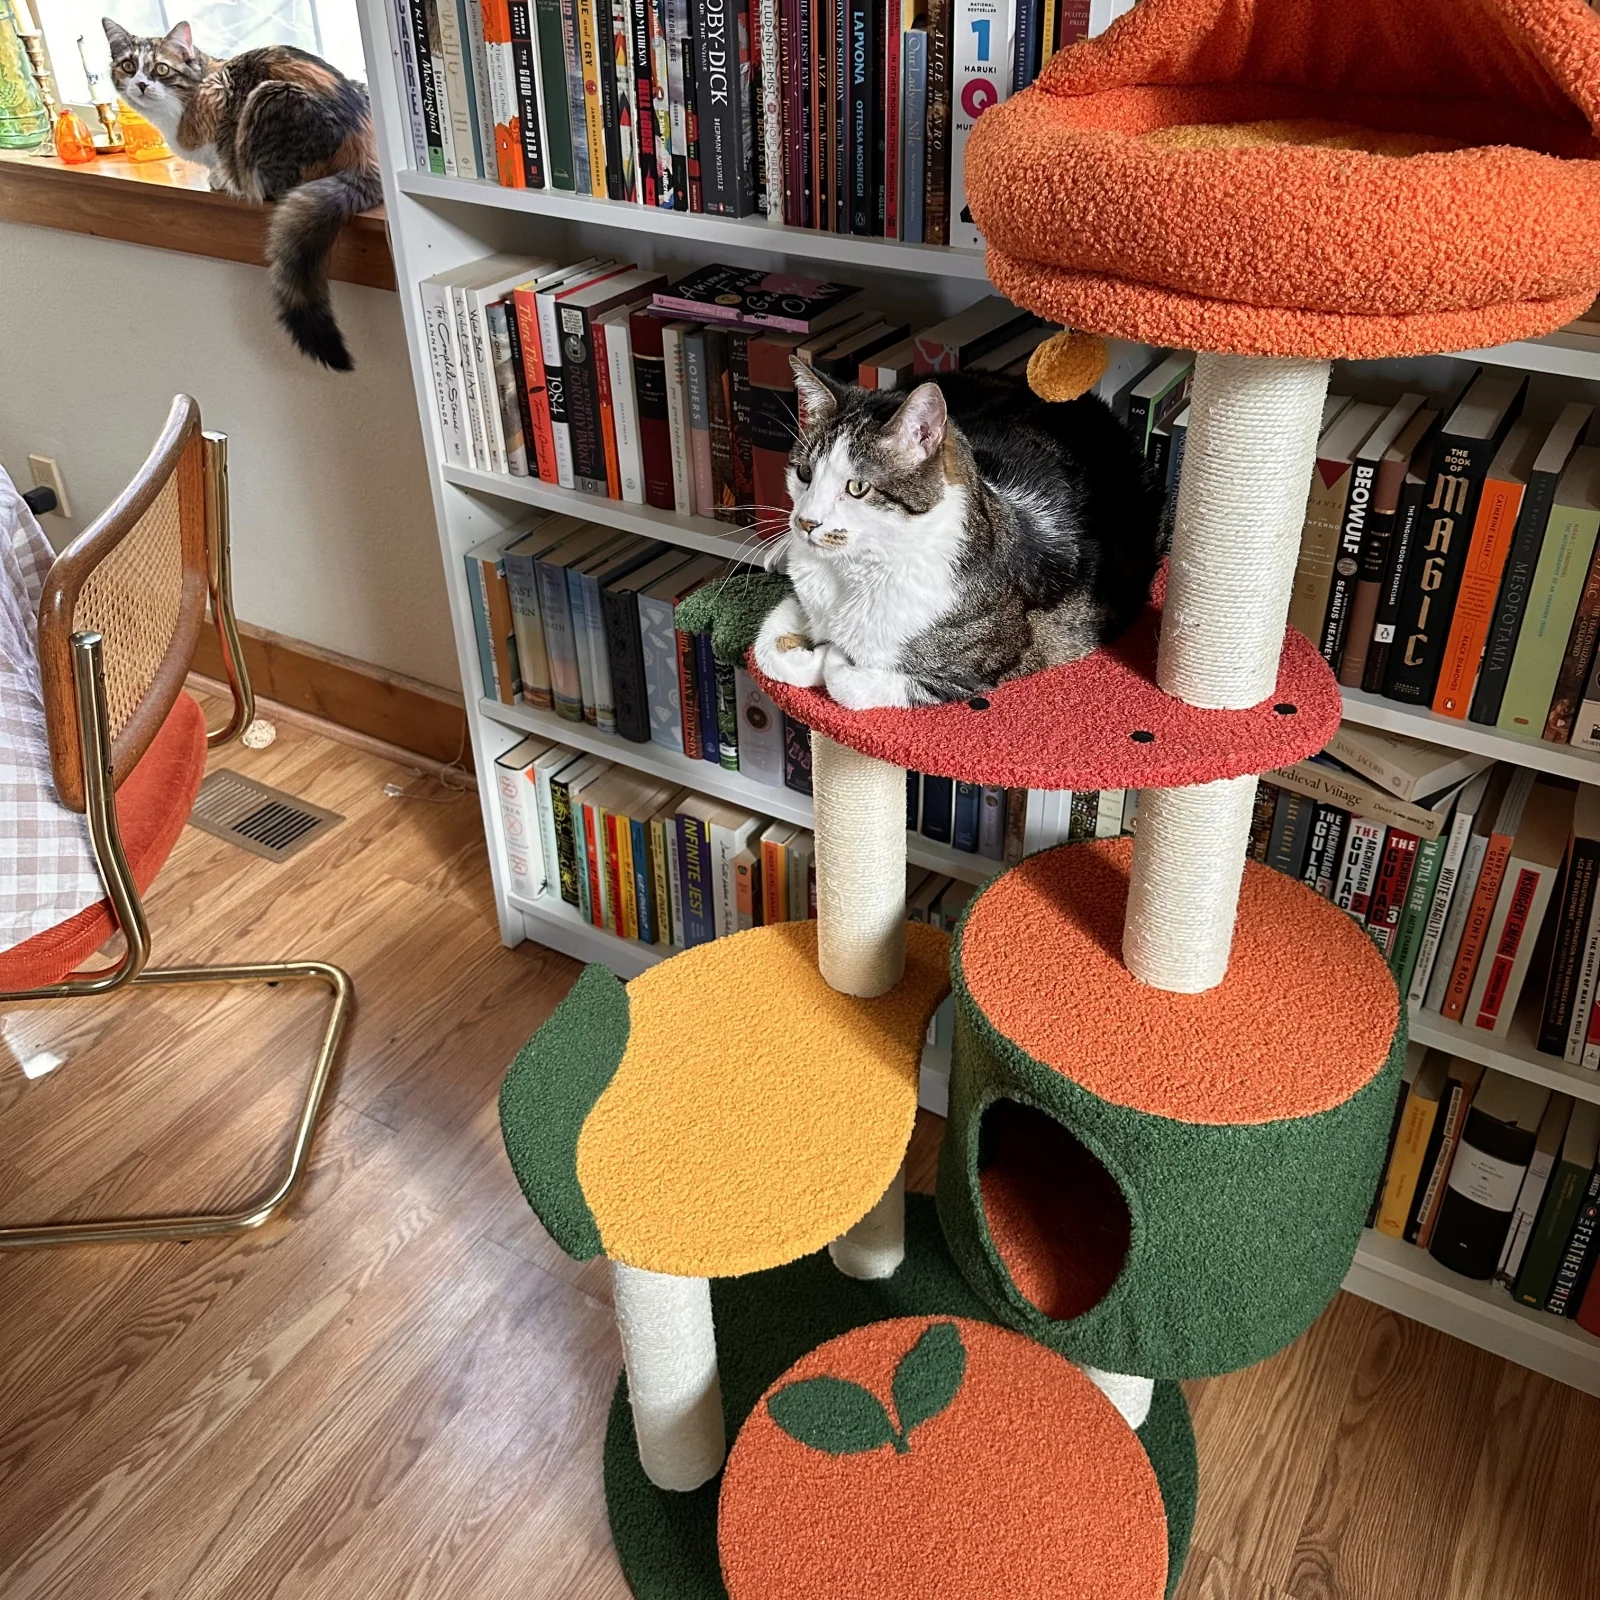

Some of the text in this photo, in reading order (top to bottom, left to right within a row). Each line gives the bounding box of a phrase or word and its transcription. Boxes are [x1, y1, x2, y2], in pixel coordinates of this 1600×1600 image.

[583, 19, 593, 67] and CRY
[637, 20, 648, 67] MATHESON
[667, 9, 676, 42] RAZOR'S
[801, 20, 809, 63] BLUEST
[853, 11, 865, 85] LAPVONA
[970, 18, 991, 62] 1
[415, 8, 440, 135] KILL Mockingbird
[669, 44, 677, 63] EDGE
[706, 0, 728, 107] OBY-DICK
[764, 5, 776, 96] LUD-IN-THE-MIST
[780, 17, 790, 84] BELOVED
[819, 54, 827, 88] JAZZ
[908, 37, 921, 66] Our
[964, 66, 997, 74] HARUKI
[519, 69, 532, 96] GOOD
[908, 68, 922, 97] Lady
[933, 29, 944, 150] ALICE MUNRO
[961, 78, 998, 119] Q
[525, 99, 534, 129] LORD
[605, 95, 613, 128] MANDELO
[640, 110, 654, 155] HOUSE
[908, 119, 921, 147] Nile
[525, 131, 538, 159] BIRD
[714, 118, 724, 192] HERMAN MELVILLE
[769, 122, 779, 193] HOPE MIRRLEES
[855, 100, 864, 197] OTTESSA MOSHFEGH
[678, 267, 739, 299] Animal
[717, 271, 767, 294] Farm
[426, 310, 439, 367] FLANNERY
[470, 309, 484, 363] Wise Blood
[490, 315, 503, 361] Jenny Offill
[518, 303, 539, 382] There There
[543, 314, 553, 360] GEORGE
[433, 300, 460, 434] The Complete Stories
[688, 352, 701, 421] MOTHERS
[547, 375, 566, 415] 1984
[1132, 407, 1146, 415] RAO
[569, 365, 592, 475] DOROTHY PARKER
[1176, 433, 1187, 464] NORSE
[1445, 456, 1472, 467] BOOK
[1449, 464, 1464, 473] OF
[1451, 448, 1469, 458] THE
[1342, 466, 1374, 554] BEOWULF
[1483, 493, 1504, 557] CATHERINE BAILEY
[1388, 519, 1413, 606] PENGUIN BOOK EXORCISMS
[1403, 472, 1470, 667] MAGIC
[1331, 580, 1346, 619] SEAMUS
[1489, 561, 1529, 671] MESOPOTAMIA
[1323, 622, 1337, 661] HEANEY
[1572, 621, 1588, 657] COLLAPSED
[1575, 634, 1593, 677] CIVILIZATION
[1450, 635, 1469, 691] BLACK DIAMONDS
[683, 669, 697, 757] JEAN THOMPSON
[1336, 741, 1385, 776] JANE JACOBS
[1271, 766, 1363, 808] Medieval Village
[1319, 810, 1343, 825] THE
[1355, 825, 1379, 839] THE
[1320, 824, 1341, 878] ARCHIPELAGO
[1356, 838, 1377, 893] ARCHIPELAGO
[1391, 837, 1416, 851] THE
[1483, 850, 1496, 878] GATES,
[684, 818, 703, 920] INFINITE JEST
[1338, 836, 1364, 910] GULAG
[1371, 848, 1399, 923] GULAG
[1391, 851, 1414, 905] ARCHIPELAGO
[1409, 840, 1439, 911] I'M STILL HERE
[1485, 846, 1507, 901] HENRY LOUIS
[1386, 910, 1399, 924] 3
[1427, 867, 1455, 939] WHITE FRAGILITY
[1501, 870, 1537, 957] INSURGENT EMPIRE
[1568, 880, 1581, 921] DEVELOPMENT
[1577, 872, 1592, 920] REVOLUTIONARY
[1454, 906, 1486, 994] STONY THE ROAD
[1579, 936, 1598, 1004] THE RIGHTS MAN
[1578, 1217, 1596, 1227] THE
[1560, 1226, 1593, 1278] FEATHER
[1549, 1278, 1573, 1314] THIEF
